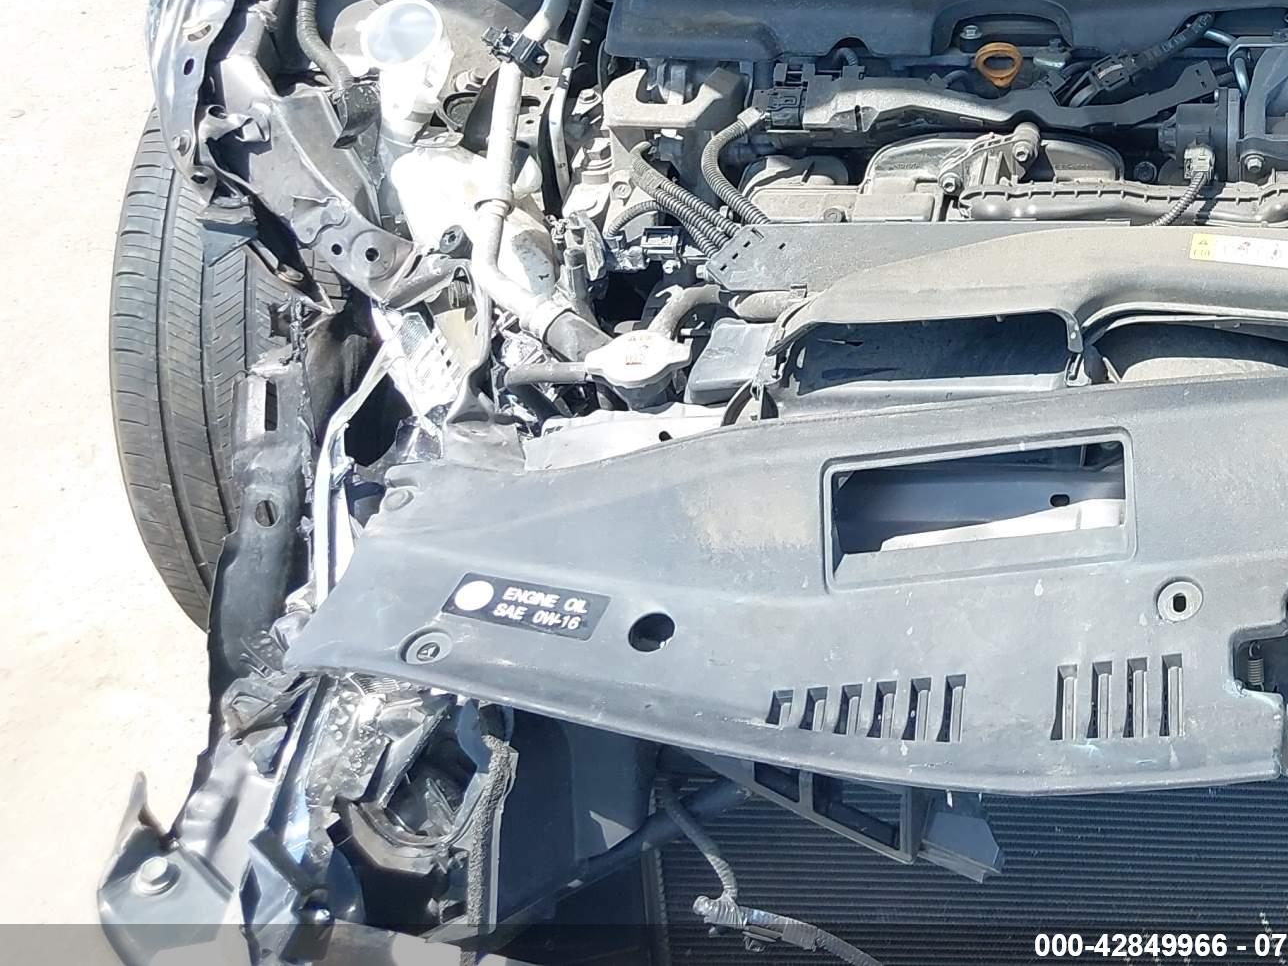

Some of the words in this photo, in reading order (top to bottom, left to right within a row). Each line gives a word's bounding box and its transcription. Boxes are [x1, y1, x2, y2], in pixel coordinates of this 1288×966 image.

[502, 586, 560, 609] ENGINE
[563, 597, 588, 614] OIL
[492, 603, 528, 620] SAE
[532, 610, 581, 630] 0W-16
